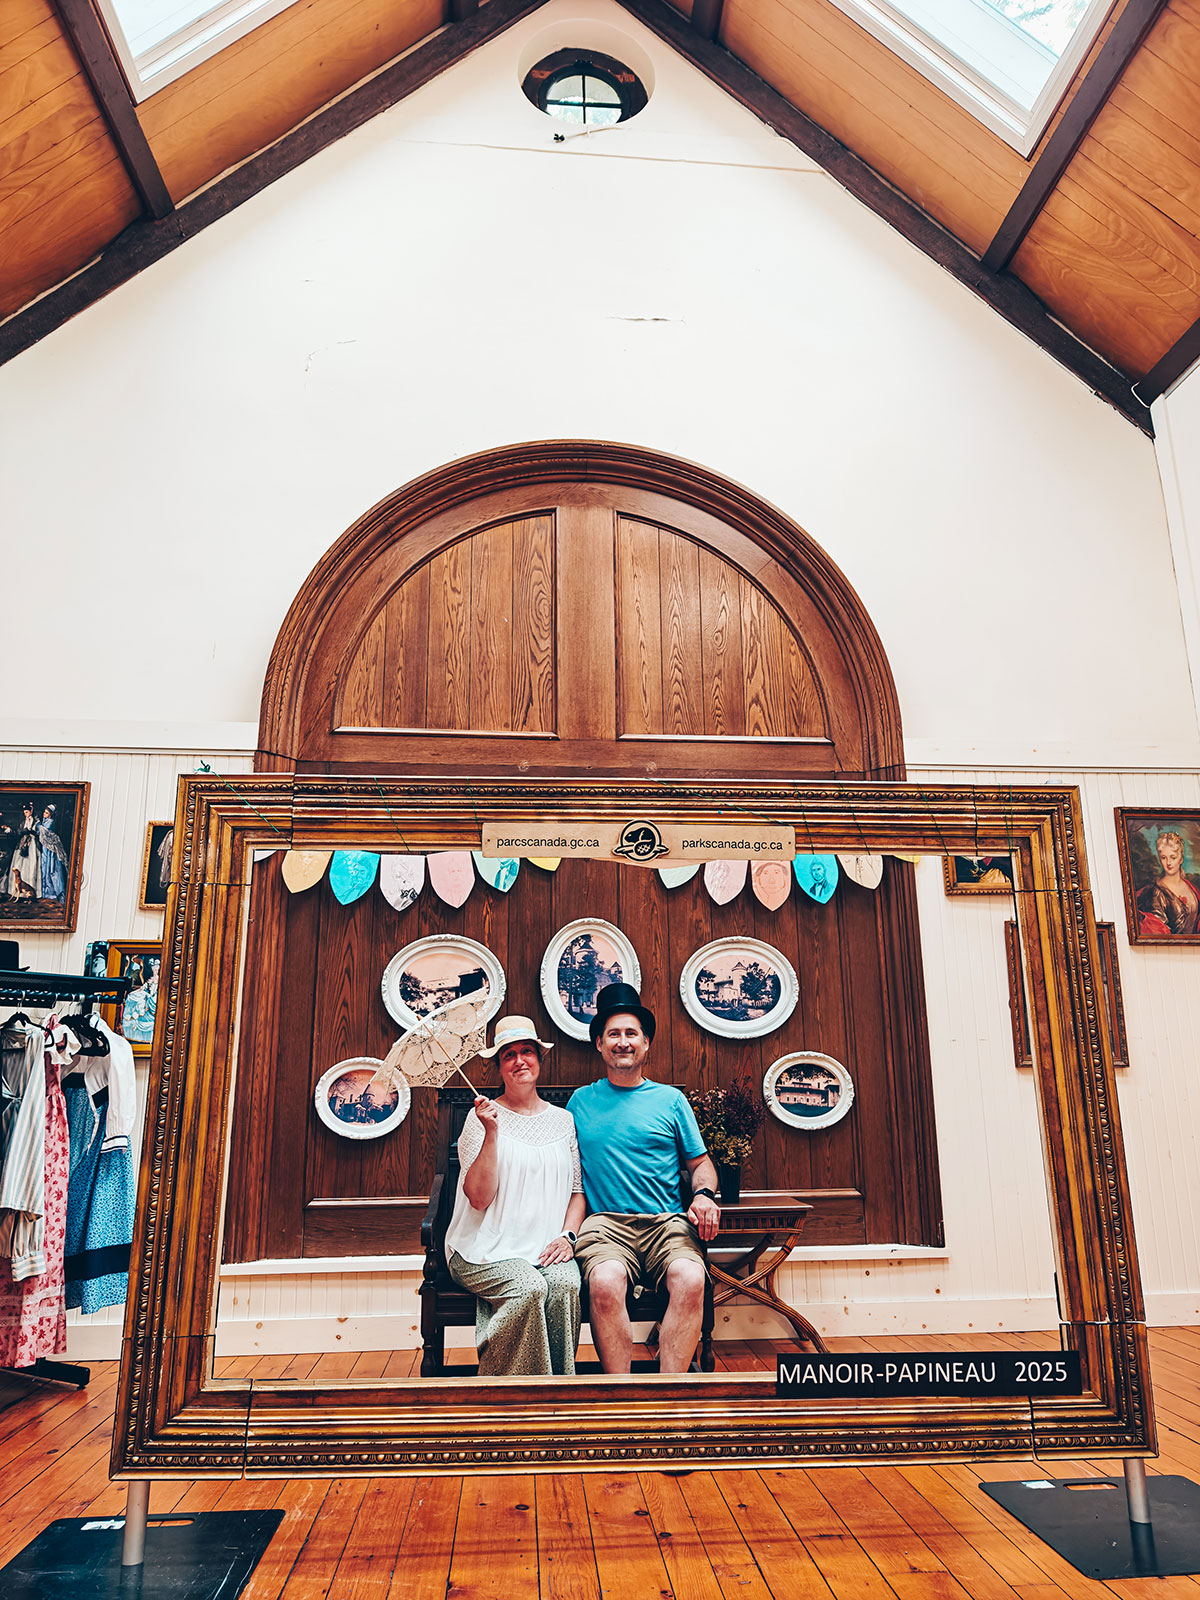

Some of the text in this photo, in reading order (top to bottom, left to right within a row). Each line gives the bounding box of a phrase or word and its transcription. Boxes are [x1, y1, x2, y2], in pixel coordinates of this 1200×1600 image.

[497, 836, 600, 850] parcscanada.gc.ca
[681, 837, 783, 851] parkscanada.gc.ca
[779, 1361, 1068, 1384] MANOIR-PAPINEAU 2025
